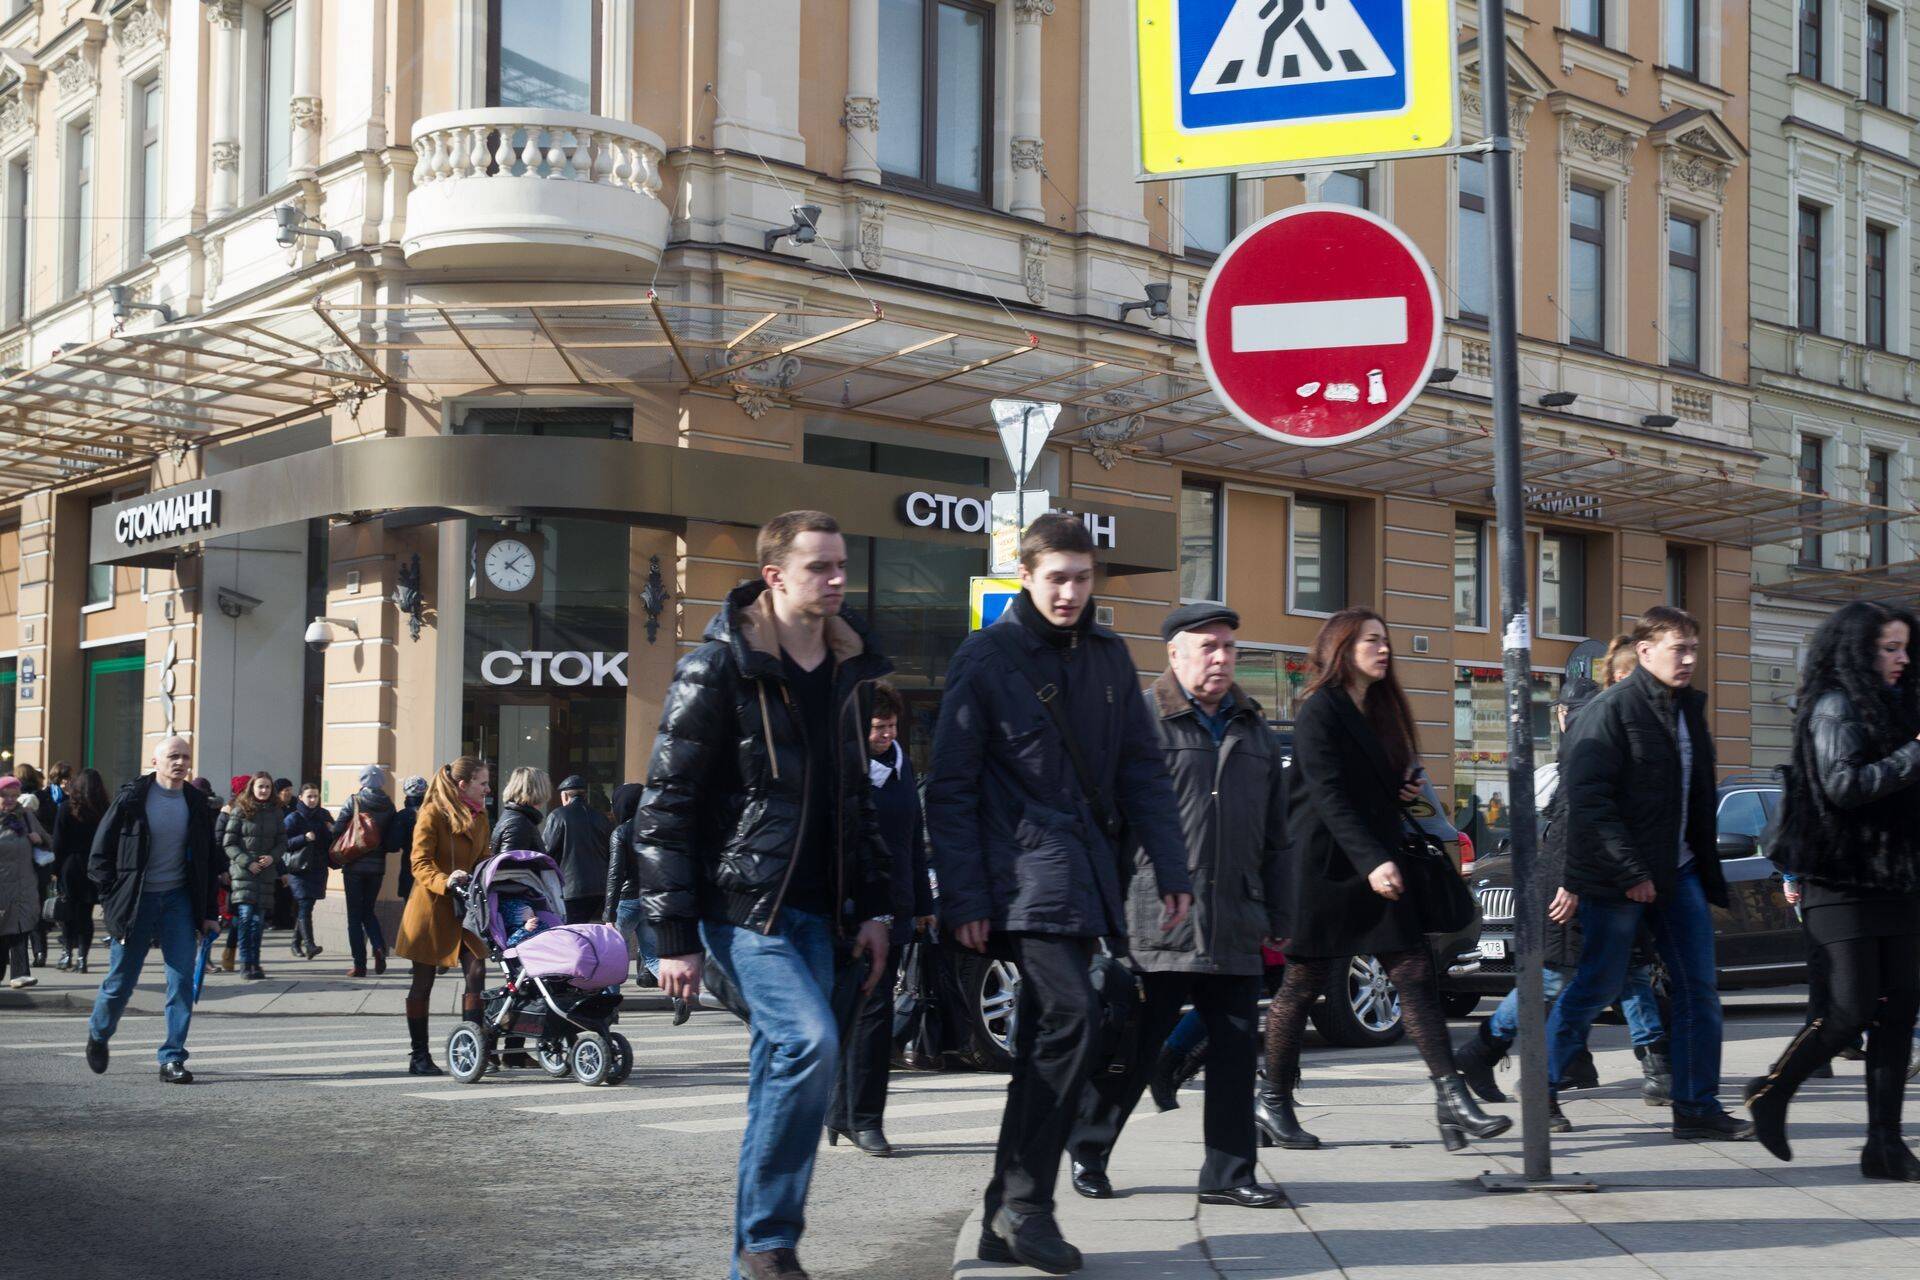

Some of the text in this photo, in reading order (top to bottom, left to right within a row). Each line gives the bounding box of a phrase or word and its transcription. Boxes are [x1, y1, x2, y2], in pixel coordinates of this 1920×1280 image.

[115, 489, 212, 543] СТОКМАНН
[481, 650, 628, 686] СТОК
[1484, 942, 1501, 951] 178
